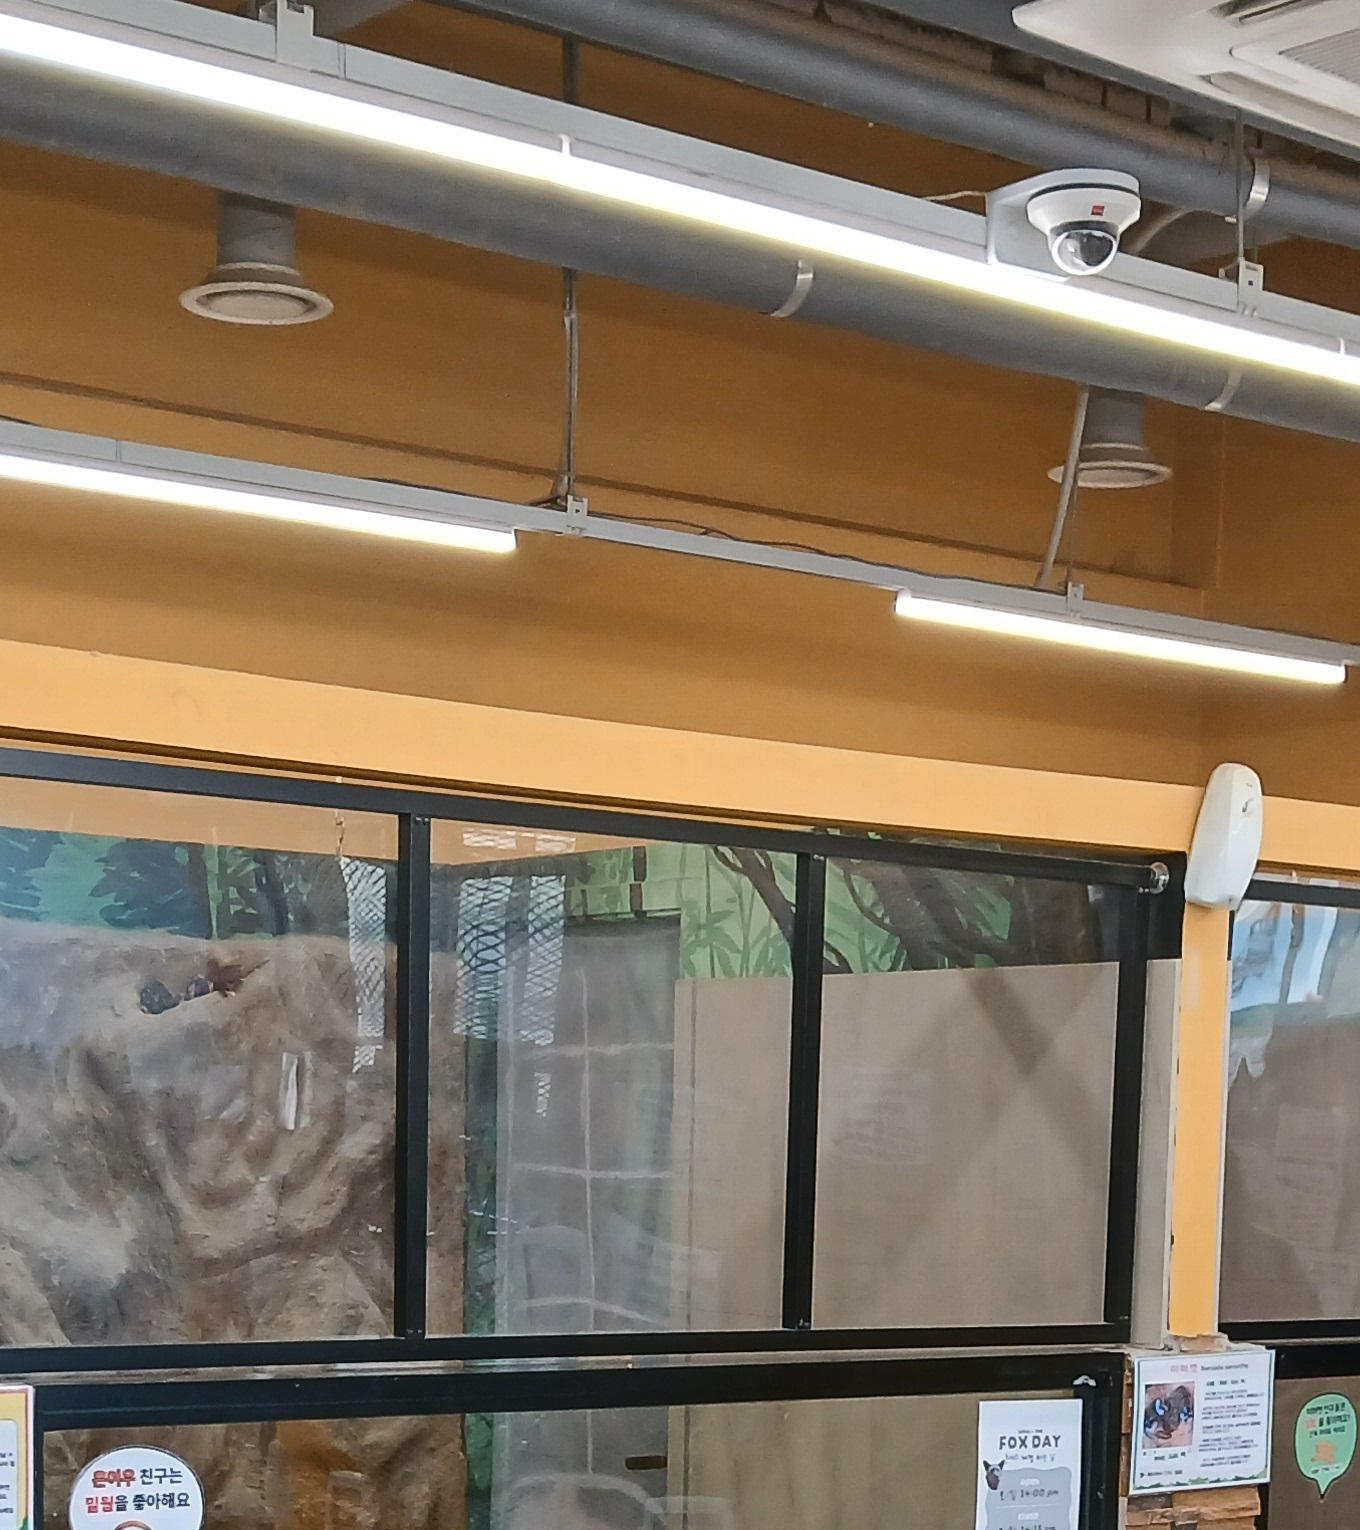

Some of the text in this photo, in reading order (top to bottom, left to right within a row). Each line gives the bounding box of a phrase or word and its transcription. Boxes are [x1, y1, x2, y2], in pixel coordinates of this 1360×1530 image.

[999, 1434, 1061, 1450] FOX DAY
[91, 1467, 183, 1488] 은여우 친구는
[132, 1492, 191, 1511] 좋아해요
